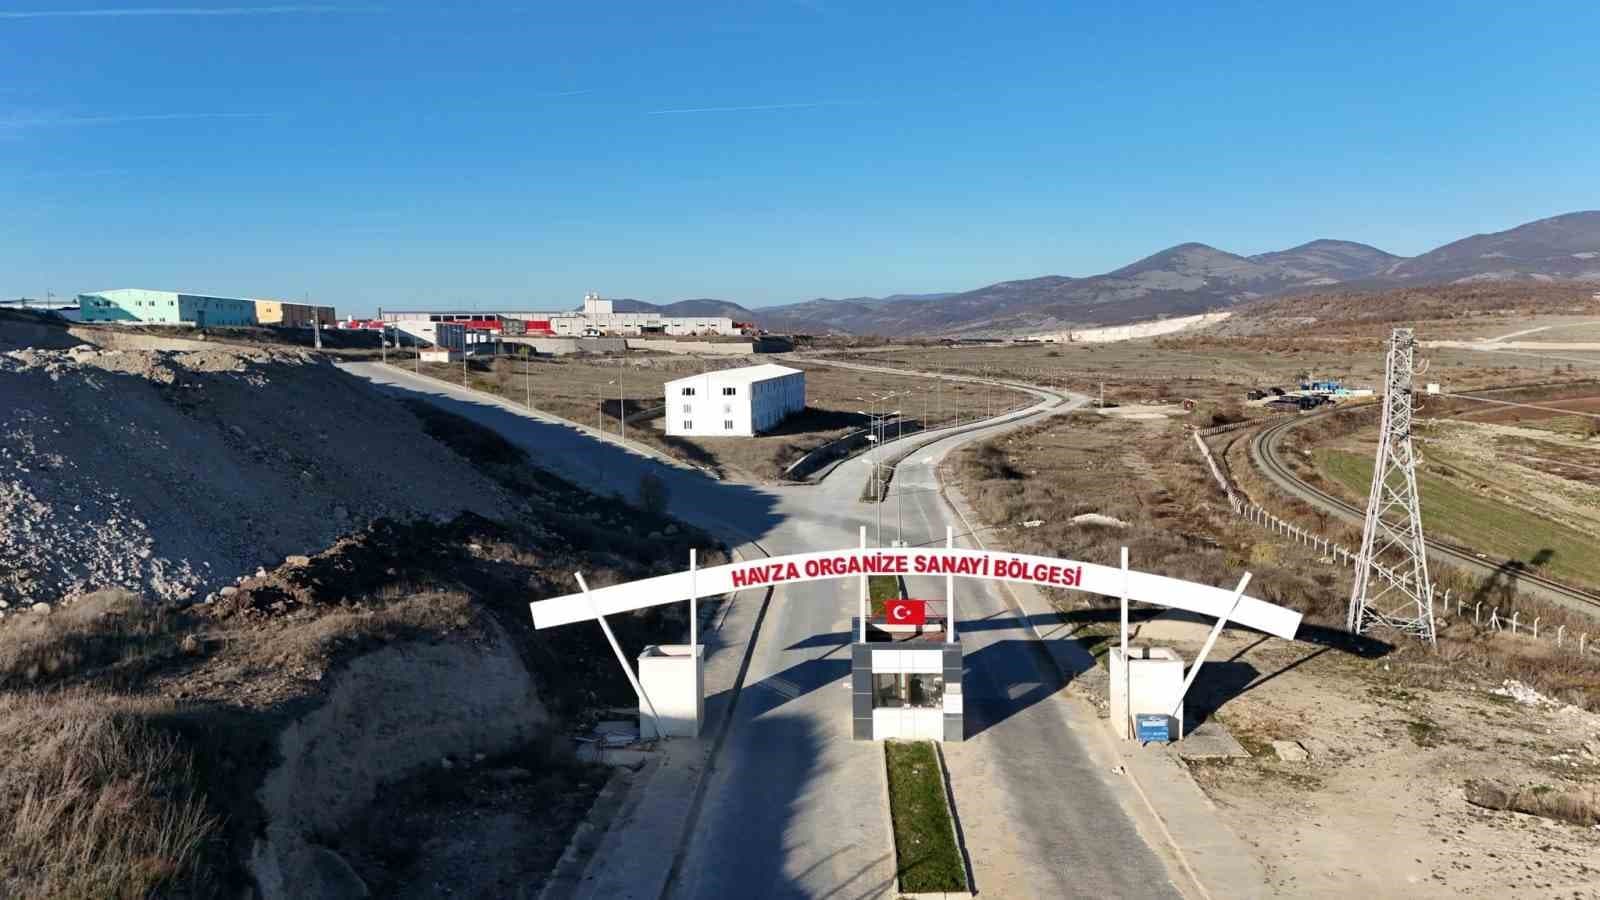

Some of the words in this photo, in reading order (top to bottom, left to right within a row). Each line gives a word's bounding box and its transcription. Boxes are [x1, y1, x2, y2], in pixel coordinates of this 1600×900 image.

[731, 562, 800, 587] HAVZA
[805, 552, 908, 577] ORGANİZE
[914, 554, 990, 577] SANAYİ
[993, 558, 1082, 587] BÖLGESİ
